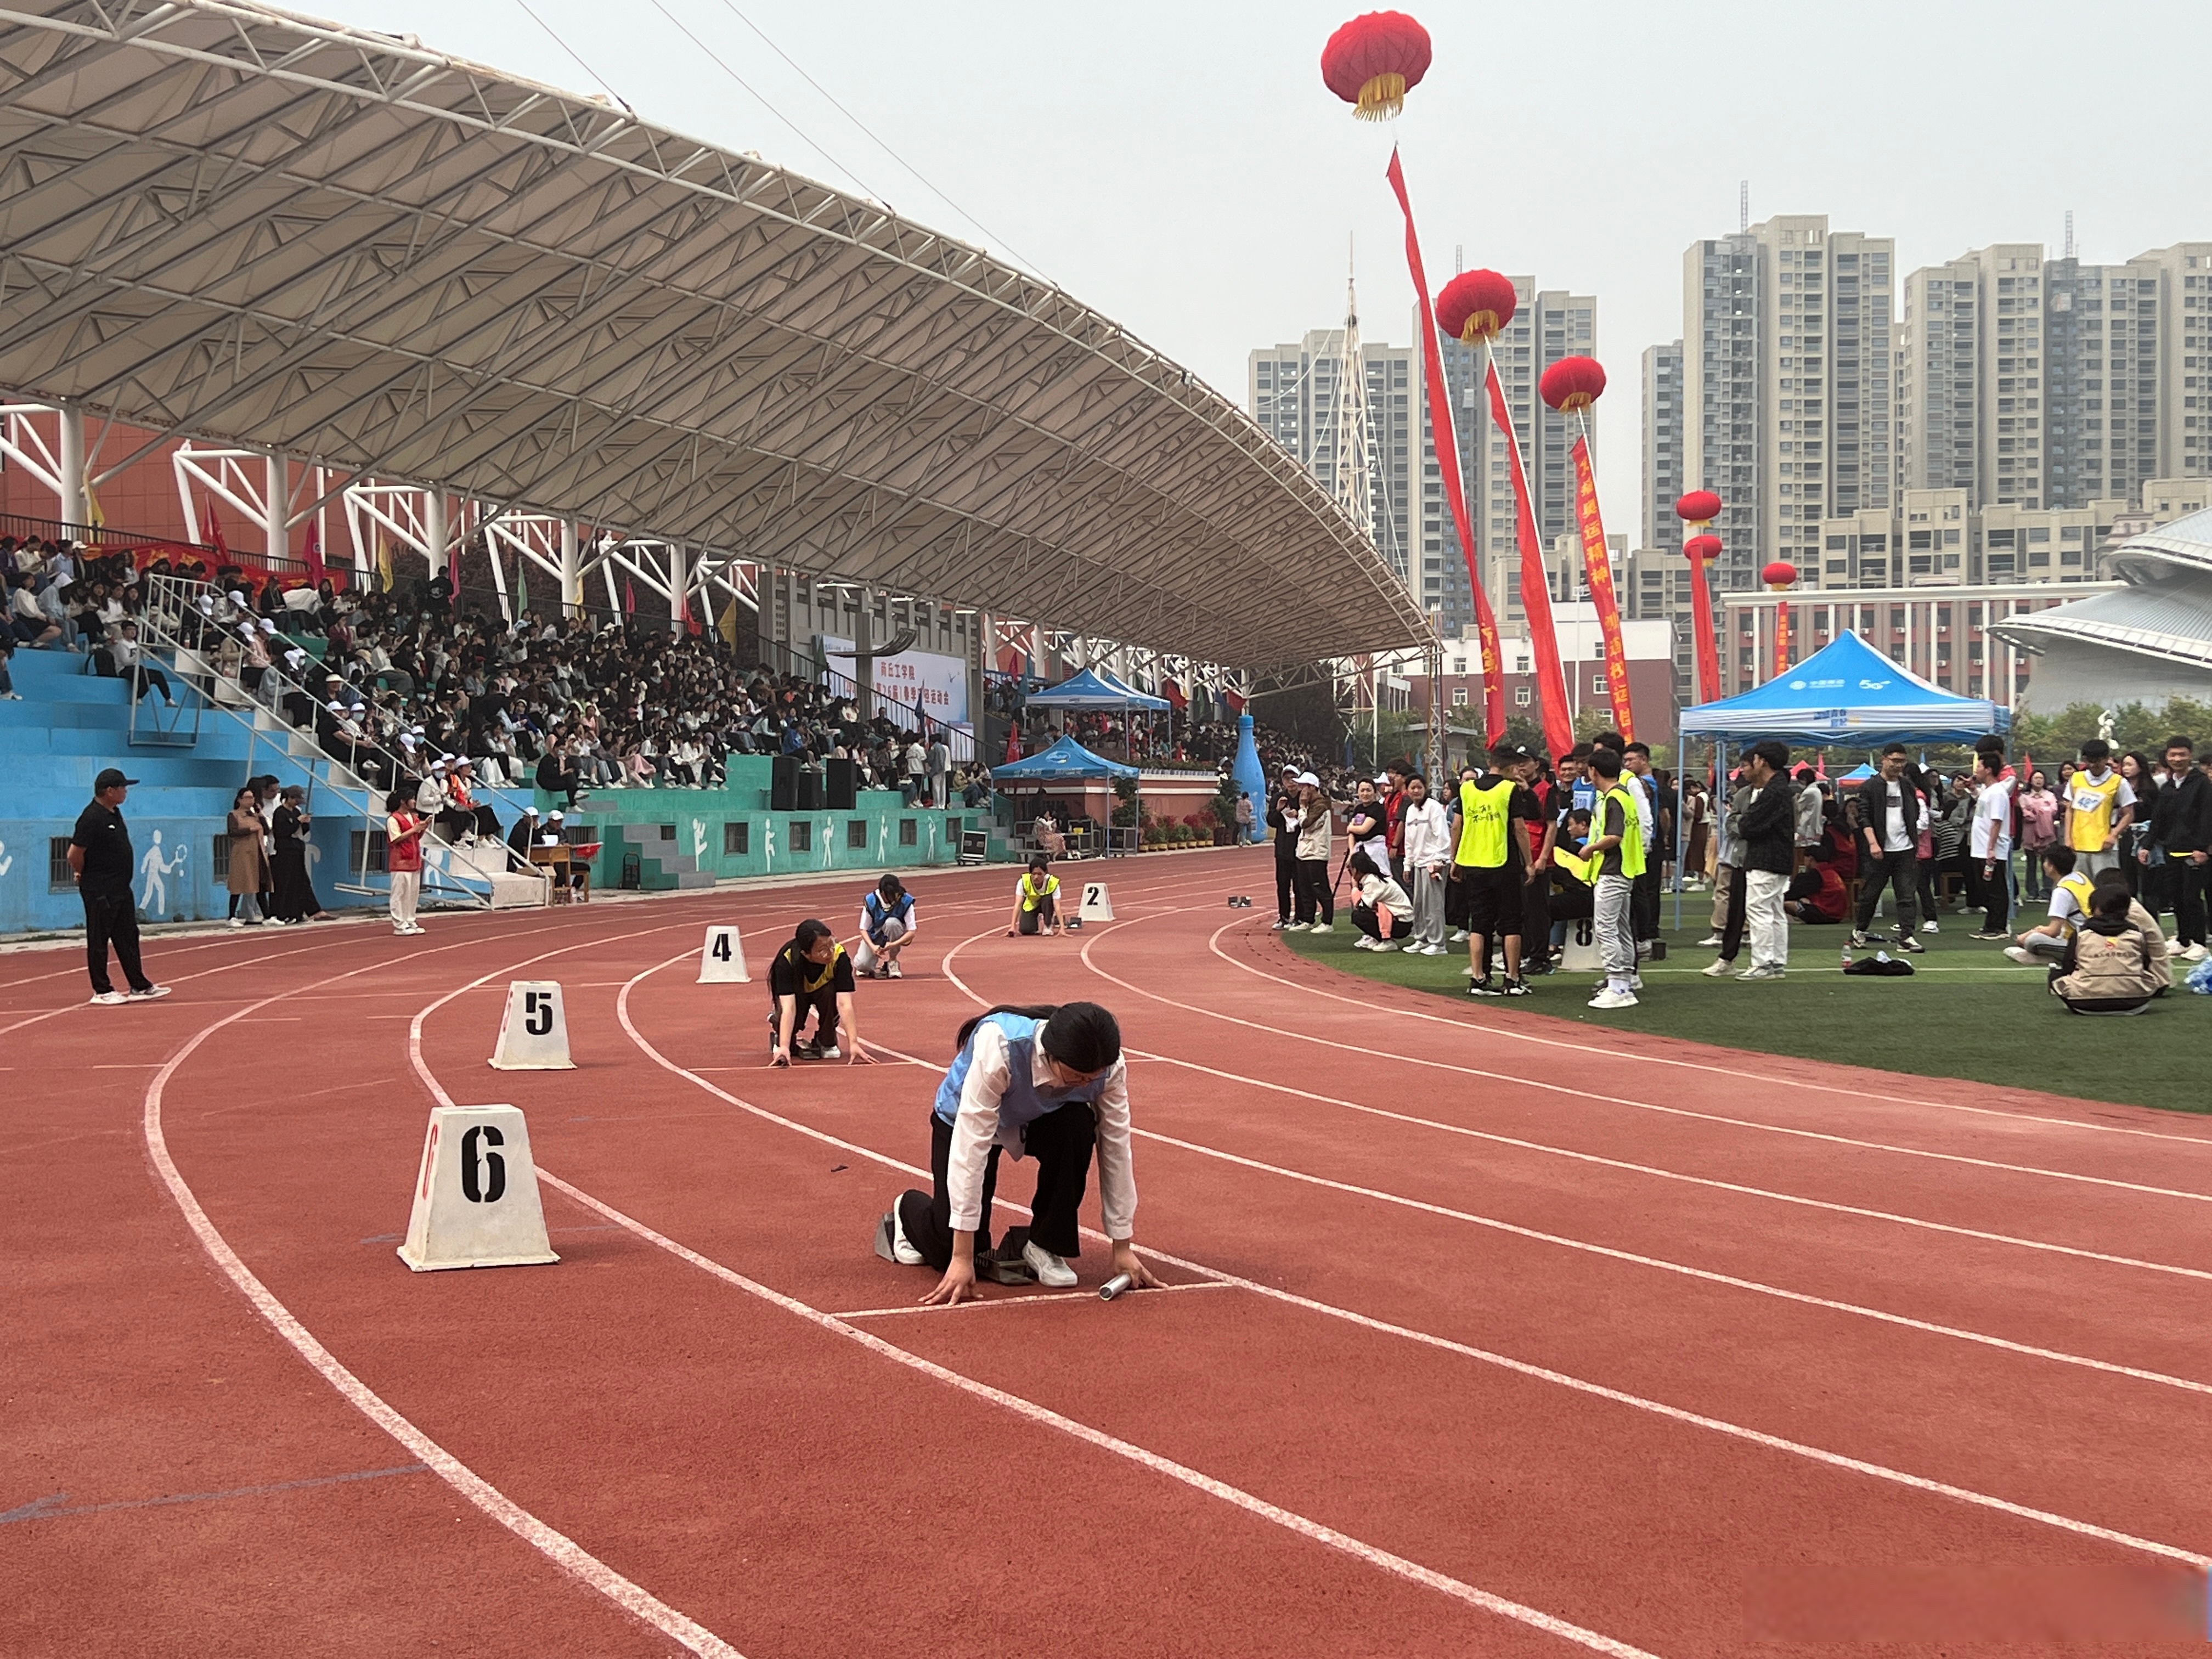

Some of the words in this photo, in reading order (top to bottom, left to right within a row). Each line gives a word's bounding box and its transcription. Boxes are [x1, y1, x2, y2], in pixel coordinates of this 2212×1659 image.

[881, 662, 915, 680] 商丘工学院
[1087, 887, 1099, 906] 2
[1576, 917, 1593, 947] 8
[713, 933, 732, 962] 4
[526, 991, 552, 1035] 5
[461, 1126, 506, 1203] 6
